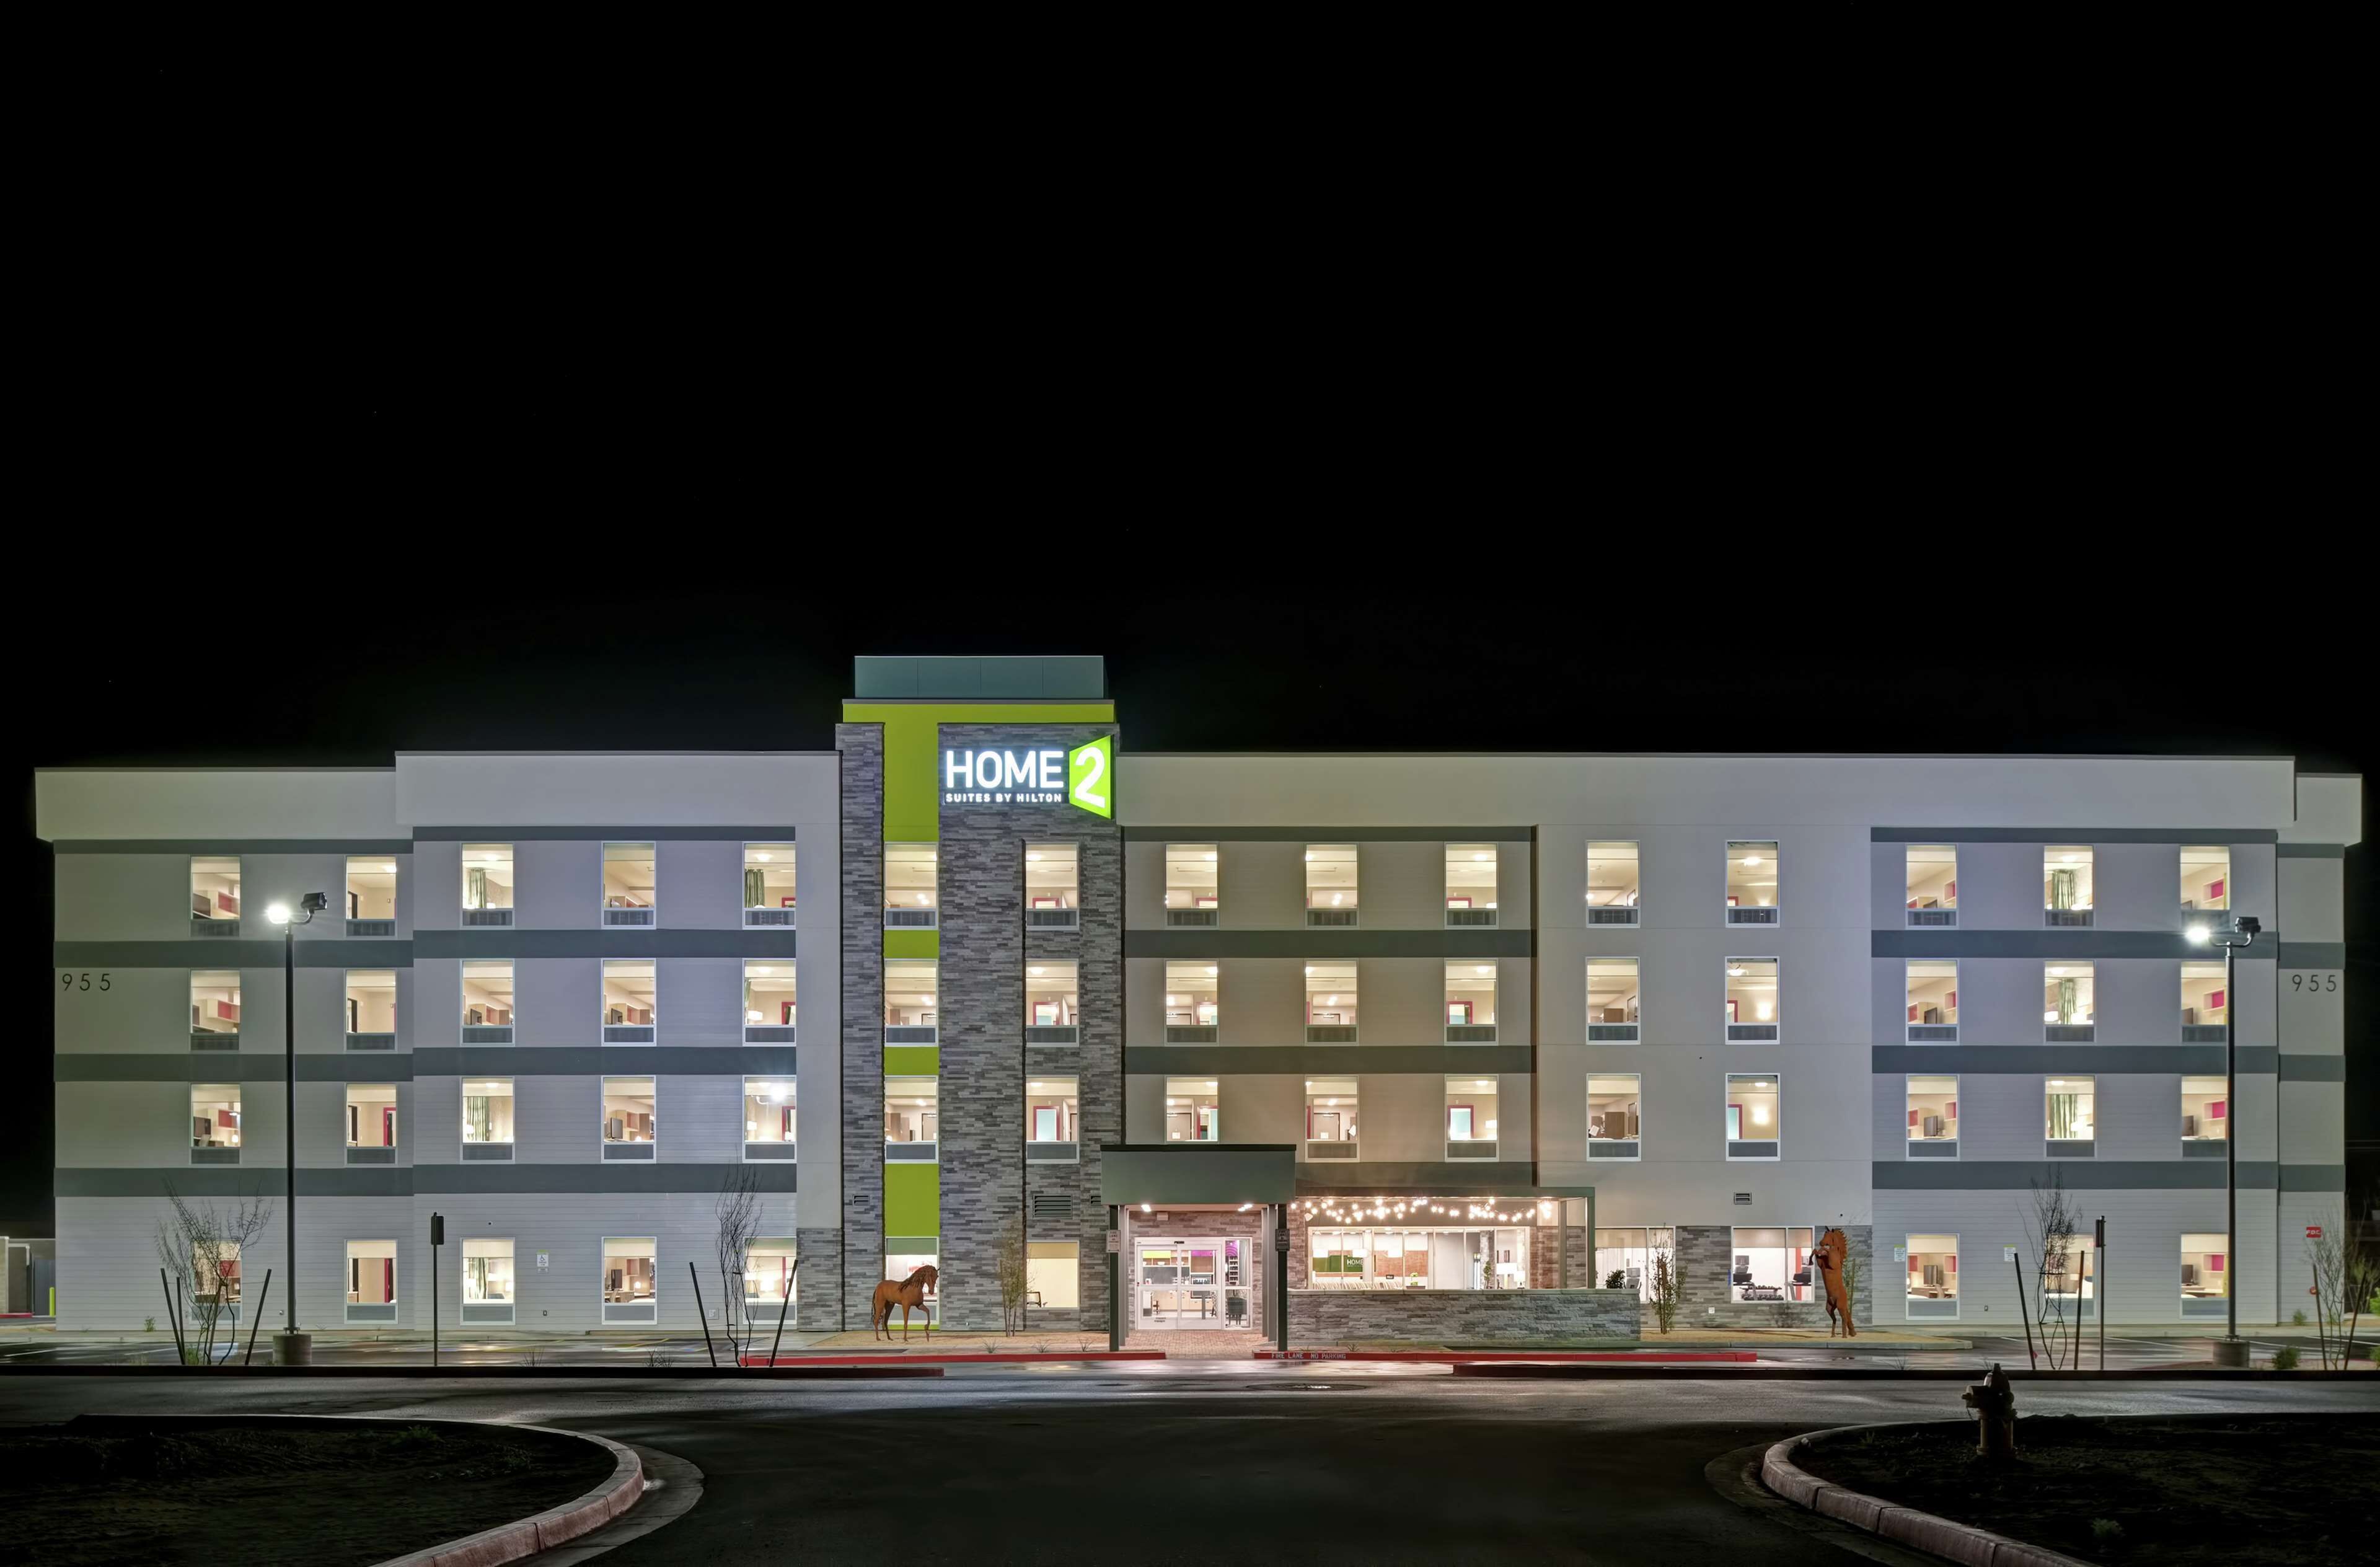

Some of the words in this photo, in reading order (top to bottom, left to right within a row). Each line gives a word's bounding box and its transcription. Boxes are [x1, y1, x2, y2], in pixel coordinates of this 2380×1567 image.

[946, 751, 1064, 788] HOME
[1074, 746, 1106, 809] 2
[946, 793, 990, 803] SUITES
[996, 793, 1011, 803] BY
[1016, 793, 1062, 803] HILTON
[62, 973, 110, 991] 955
[2292, 974, 2337, 992] 955
